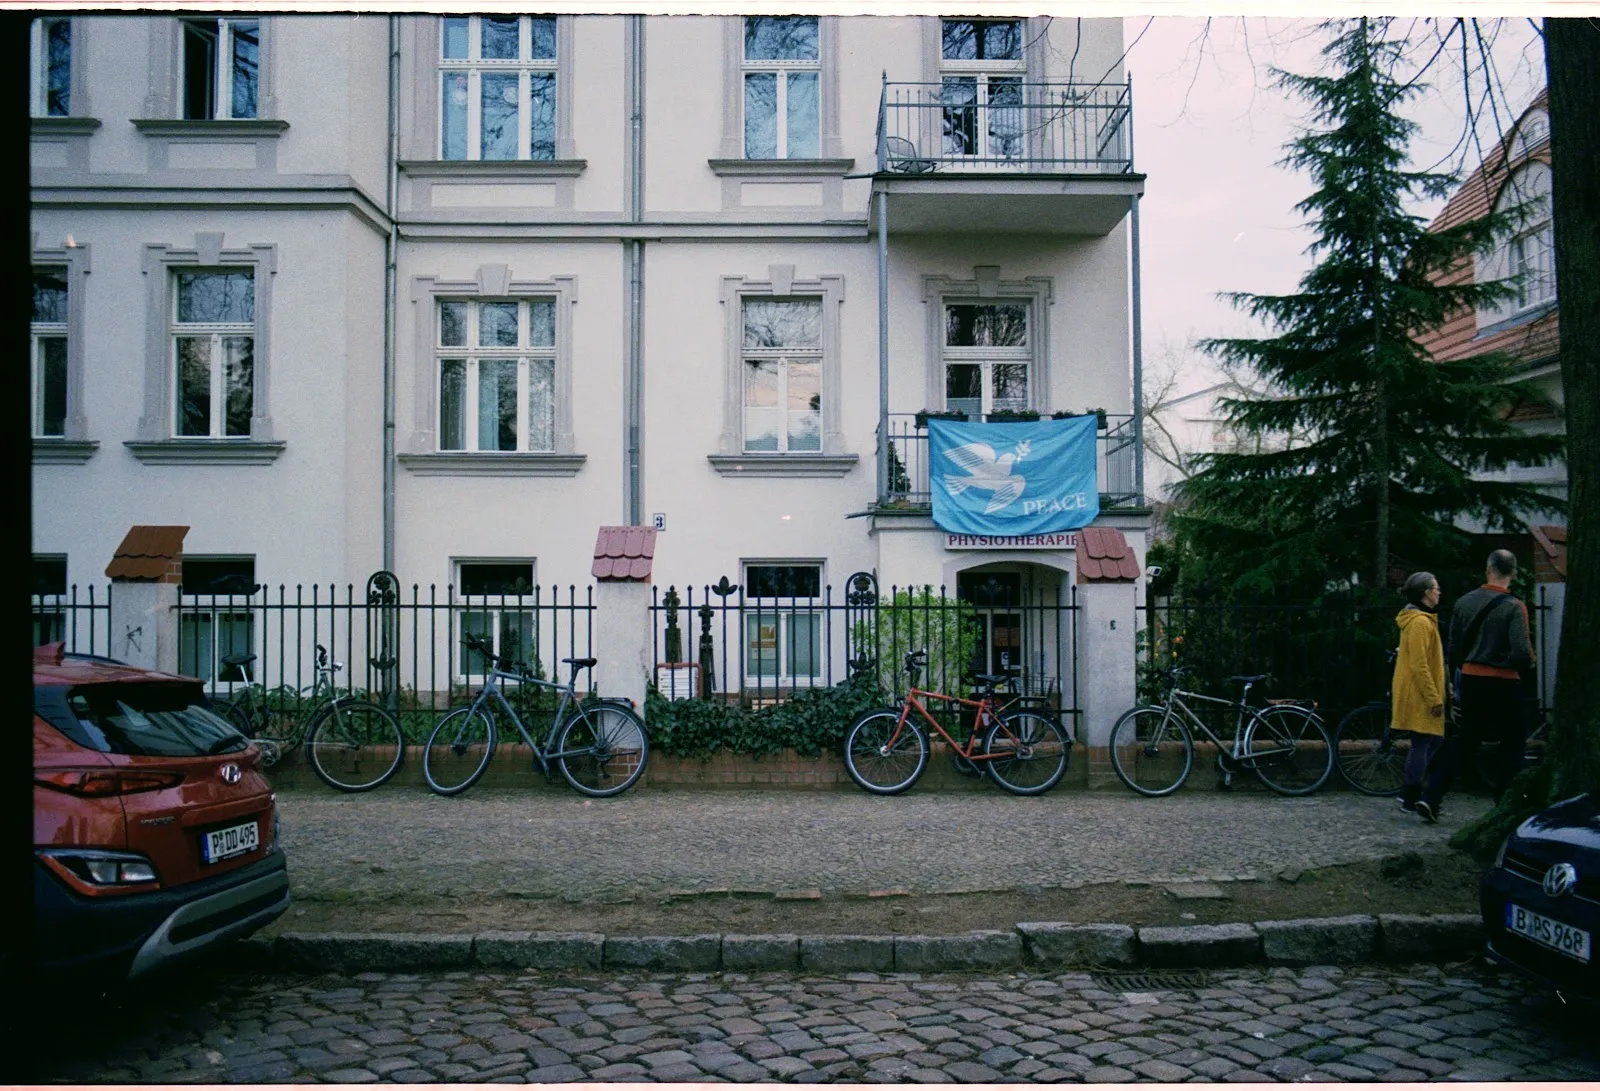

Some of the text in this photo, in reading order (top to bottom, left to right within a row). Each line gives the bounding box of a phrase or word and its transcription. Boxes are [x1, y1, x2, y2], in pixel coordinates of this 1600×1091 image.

[1023, 491, 1088, 516] PEACE
[656, 515, 663, 528] 3
[212, 834, 219, 855] P
[225, 829, 238, 851] DD
[239, 824, 256, 846] 495
[1517, 908, 1583, 953] B PS 968
